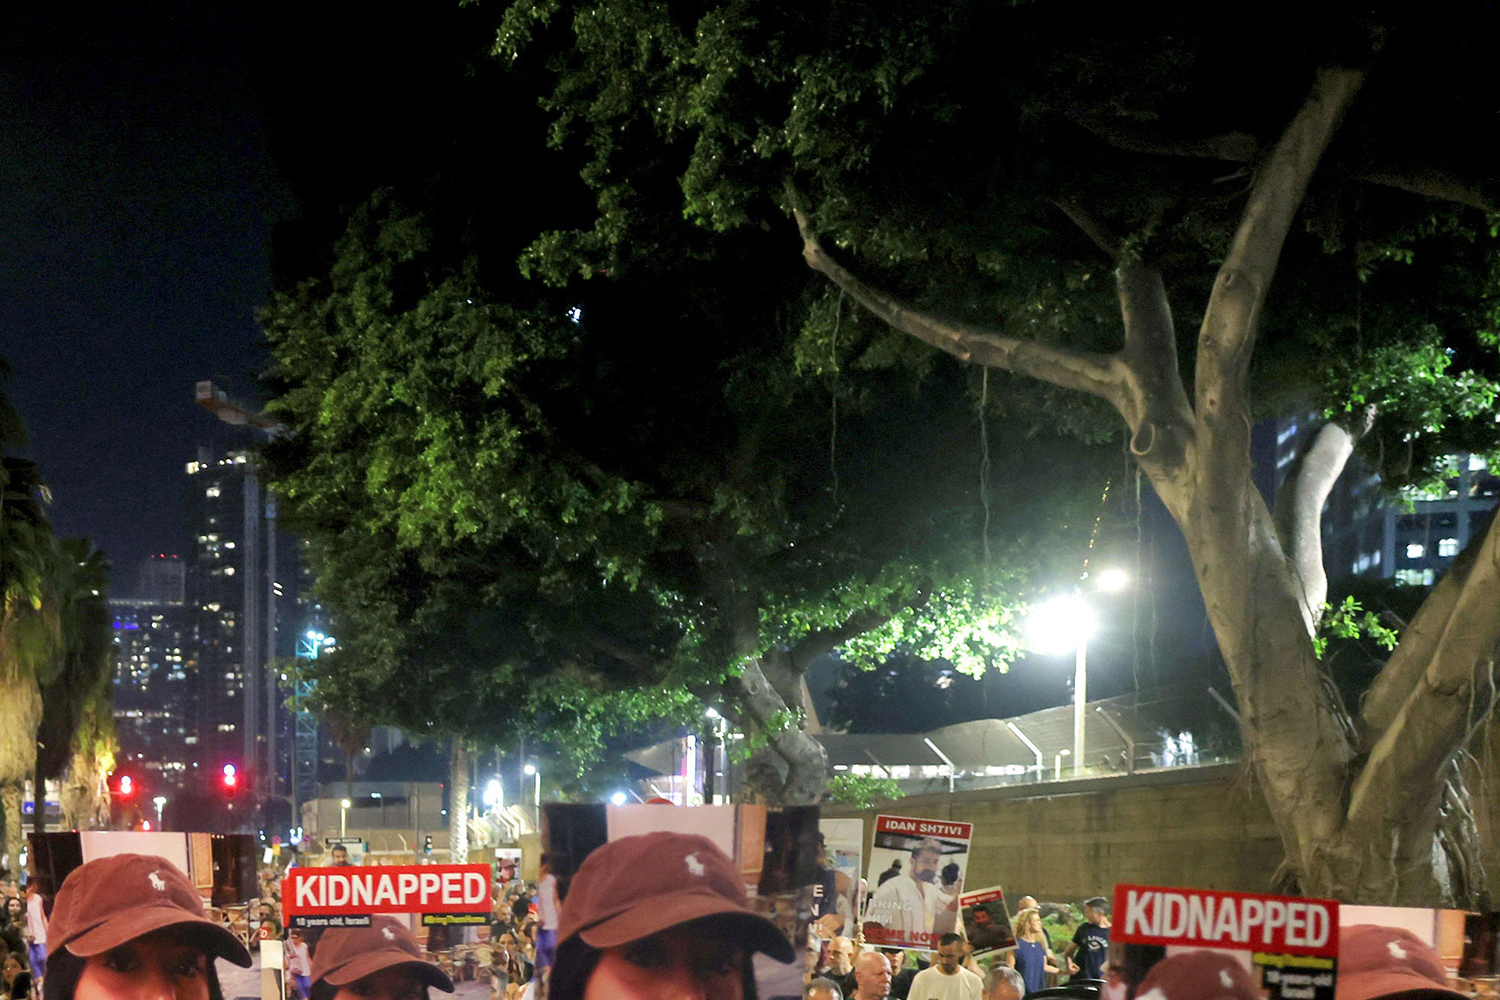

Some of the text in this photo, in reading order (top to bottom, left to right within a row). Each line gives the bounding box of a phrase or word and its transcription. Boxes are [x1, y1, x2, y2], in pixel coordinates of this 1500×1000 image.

[885, 819, 963, 836] IDAN SHTIVI
[295, 872, 487, 907] KIDNAPPED
[1124, 890, 1330, 948] KIDNAPPED
